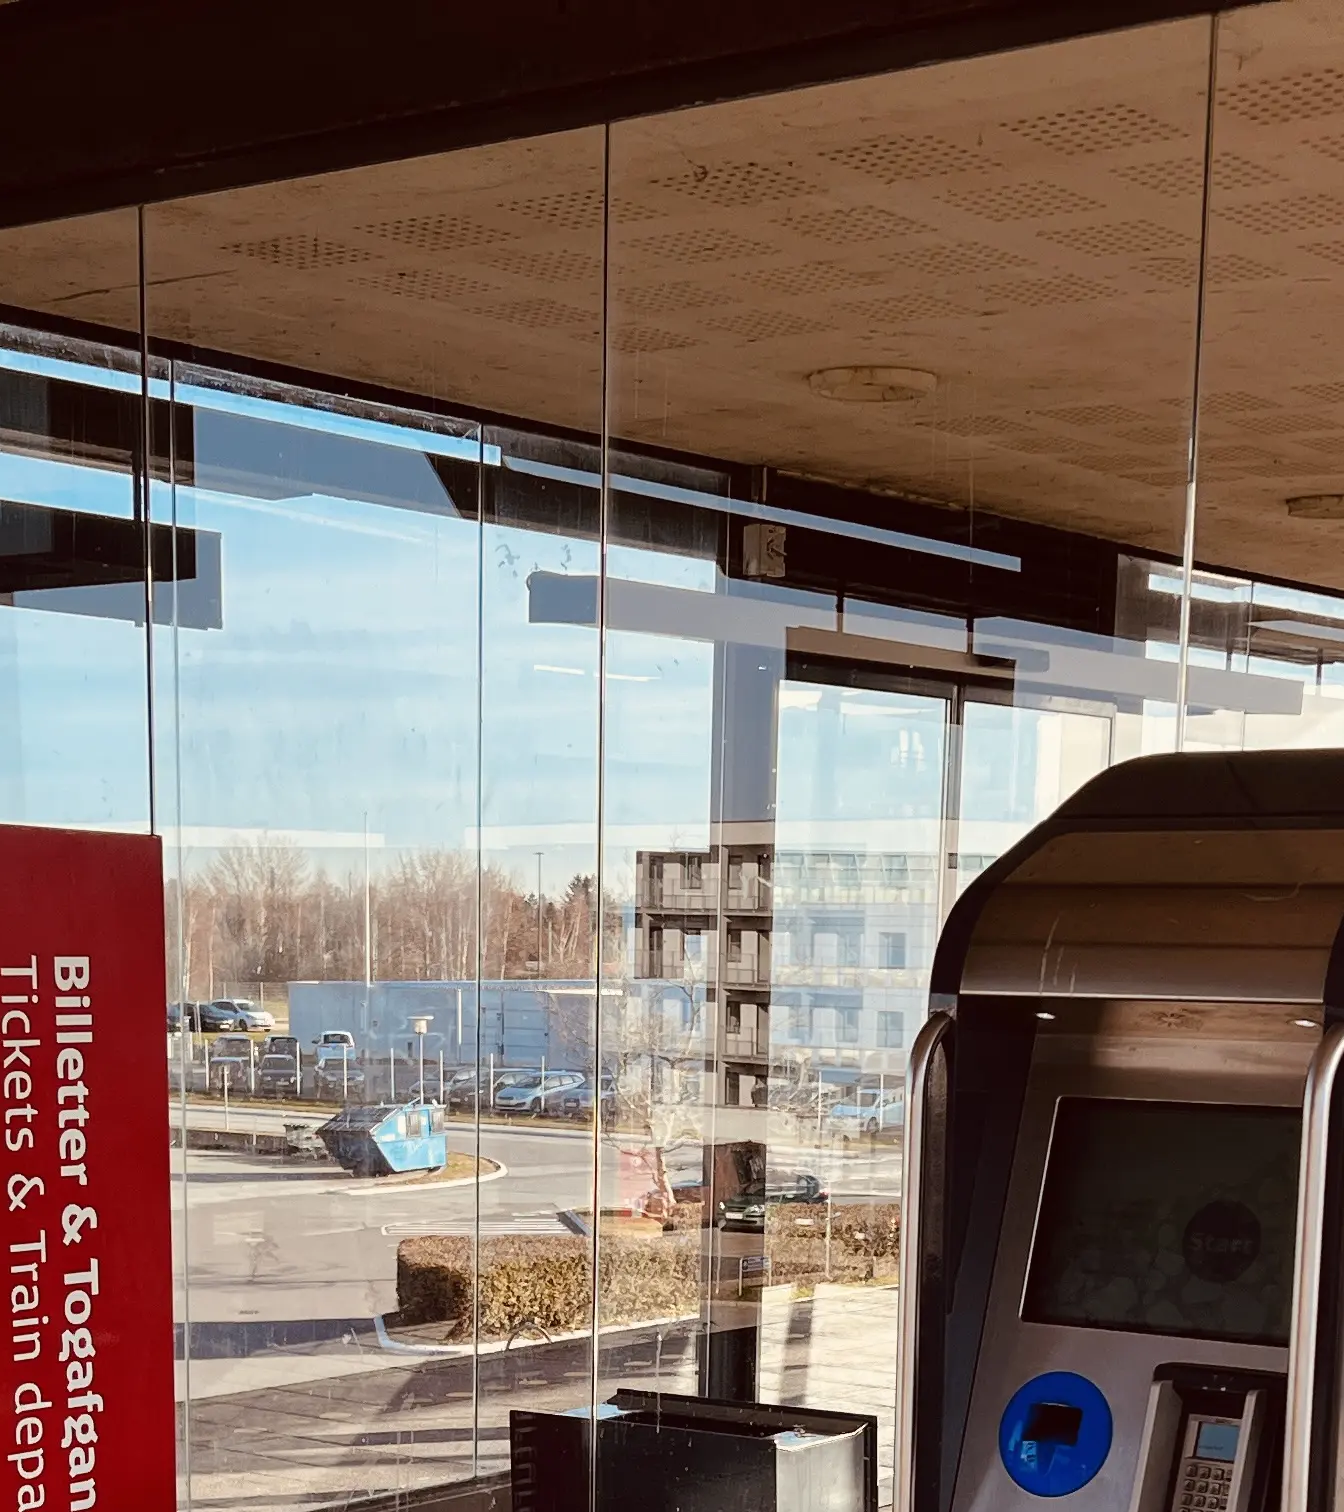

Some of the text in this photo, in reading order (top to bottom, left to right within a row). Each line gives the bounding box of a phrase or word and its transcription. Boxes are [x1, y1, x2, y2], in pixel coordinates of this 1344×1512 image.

[0, 954, 42, 1152] Tickets
[53, 955, 94, 1186] Billetter
[7, 1173, 45, 1213] &
[61, 1203, 98, 1247] &
[1188, 1233, 1255, 1255] Start
[9, 1229, 50, 1362] Train
